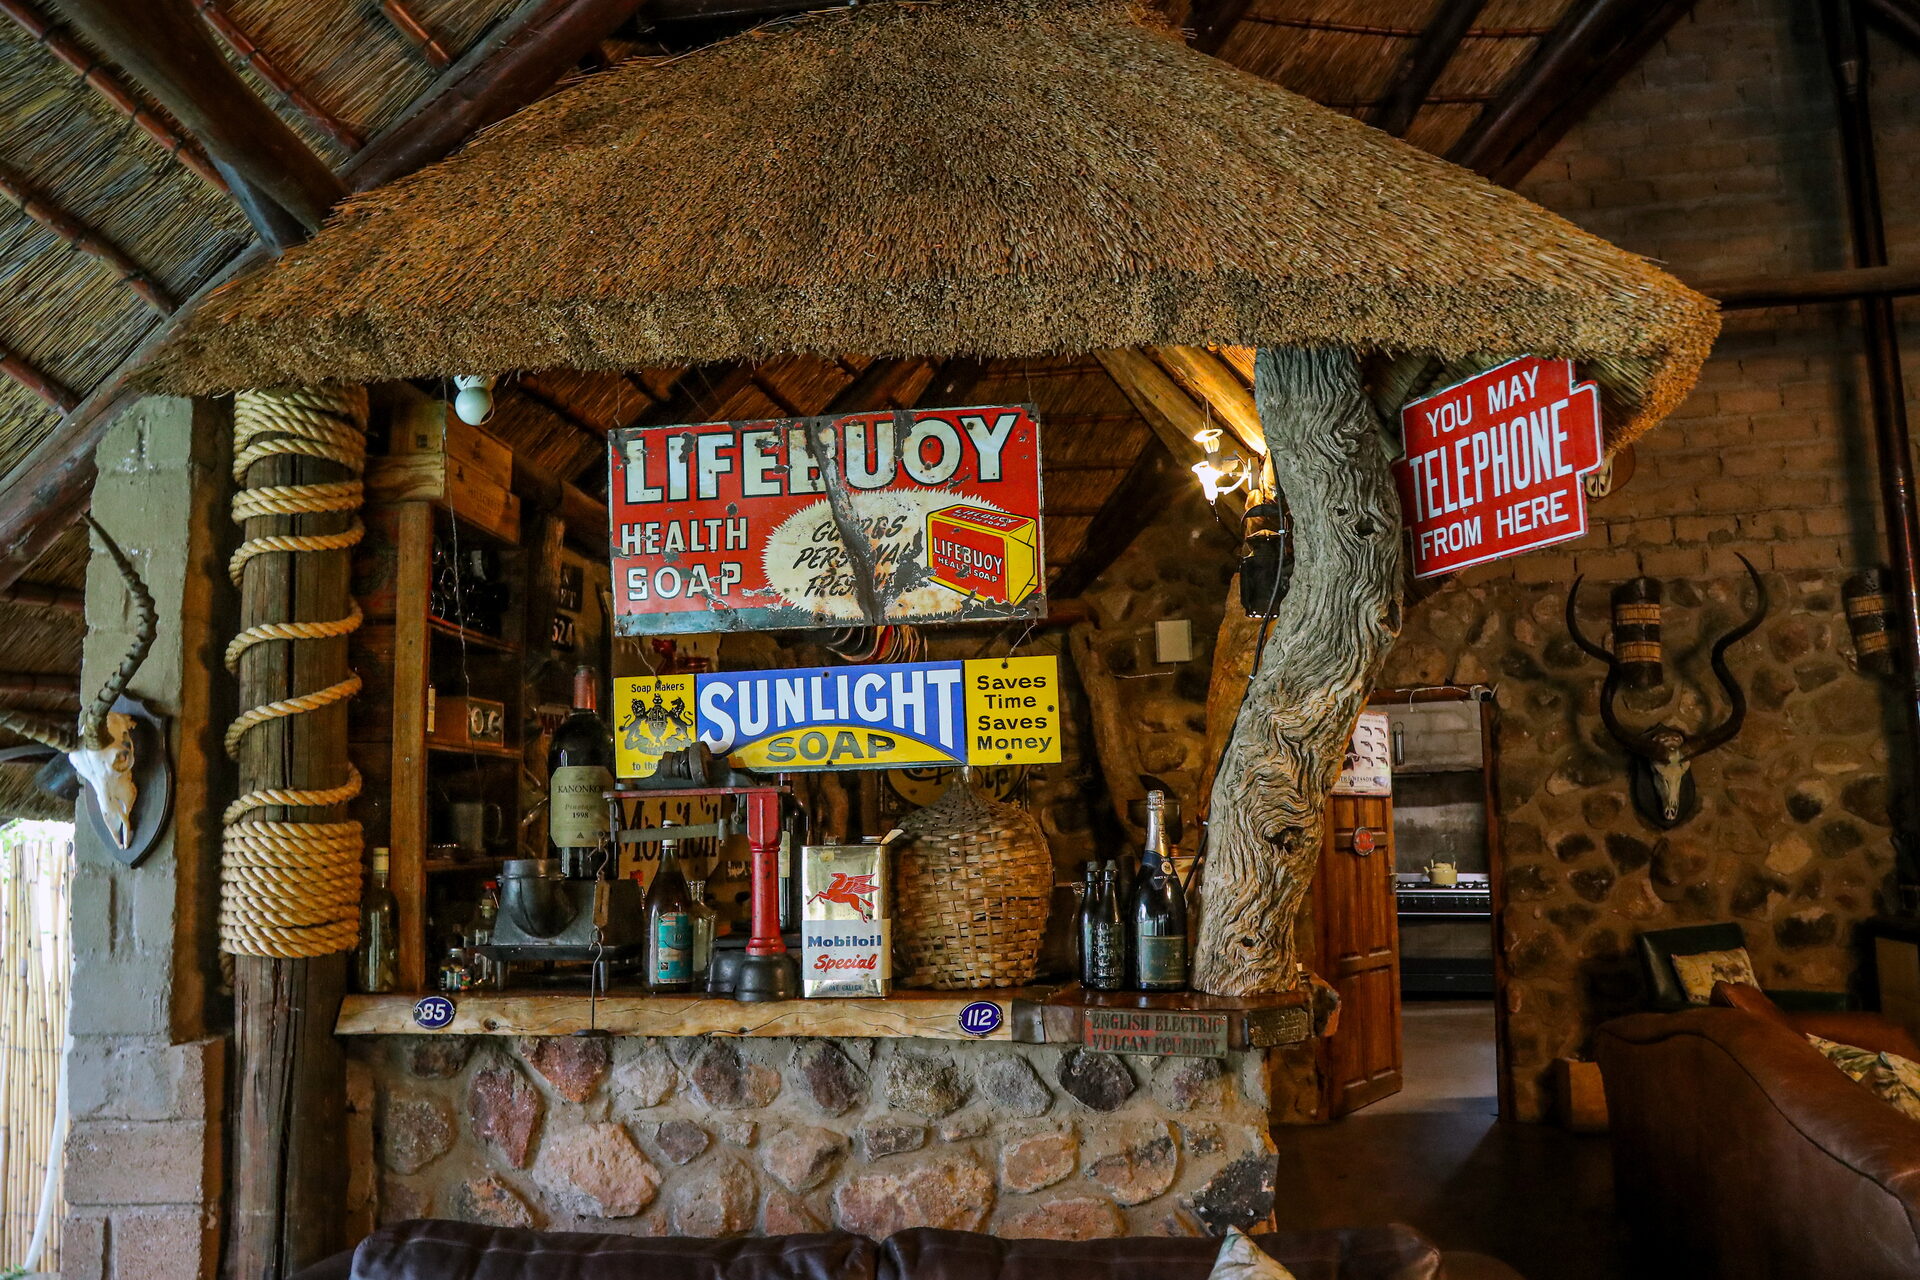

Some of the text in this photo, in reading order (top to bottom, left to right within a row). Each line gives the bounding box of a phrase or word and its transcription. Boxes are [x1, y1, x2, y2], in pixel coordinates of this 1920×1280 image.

[1426, 366, 1539, 438] YOU MAY
[625, 412, 1021, 505] LIFEBUOY
[1409, 398, 1573, 523] TELEPHONE
[1420, 489, 1570, 561] FROM HERE
[621, 516, 748, 556] HEALTH
[933, 537, 1003, 575] LIFEBUOY
[627, 561, 743, 601] SOAP
[972, 569, 998, 583] SOAP
[631, 683, 652, 694] Soap
[977, 675, 1047, 690] Saves
[984, 694, 1037, 709] Time
[700, 669, 961, 755] SUNLIGHT
[978, 715, 1048, 731] Saves
[766, 731, 896, 763] SOAP
[977, 735, 1053, 753] Money
[632, 762, 641, 771] to
[572, 811, 589, 819] 1998
[807, 934, 882, 948] Mobiloil
[813, 953, 879, 973] Special
[423, 1003, 446, 1021] 85
[967, 1008, 993, 1026] 112
[1093, 1012, 1150, 1031] ENGLISH
[1155, 1015, 1221, 1033] ELECTRIC
[1093, 1033, 1217, 1055] VULCAN FOUNDRY
